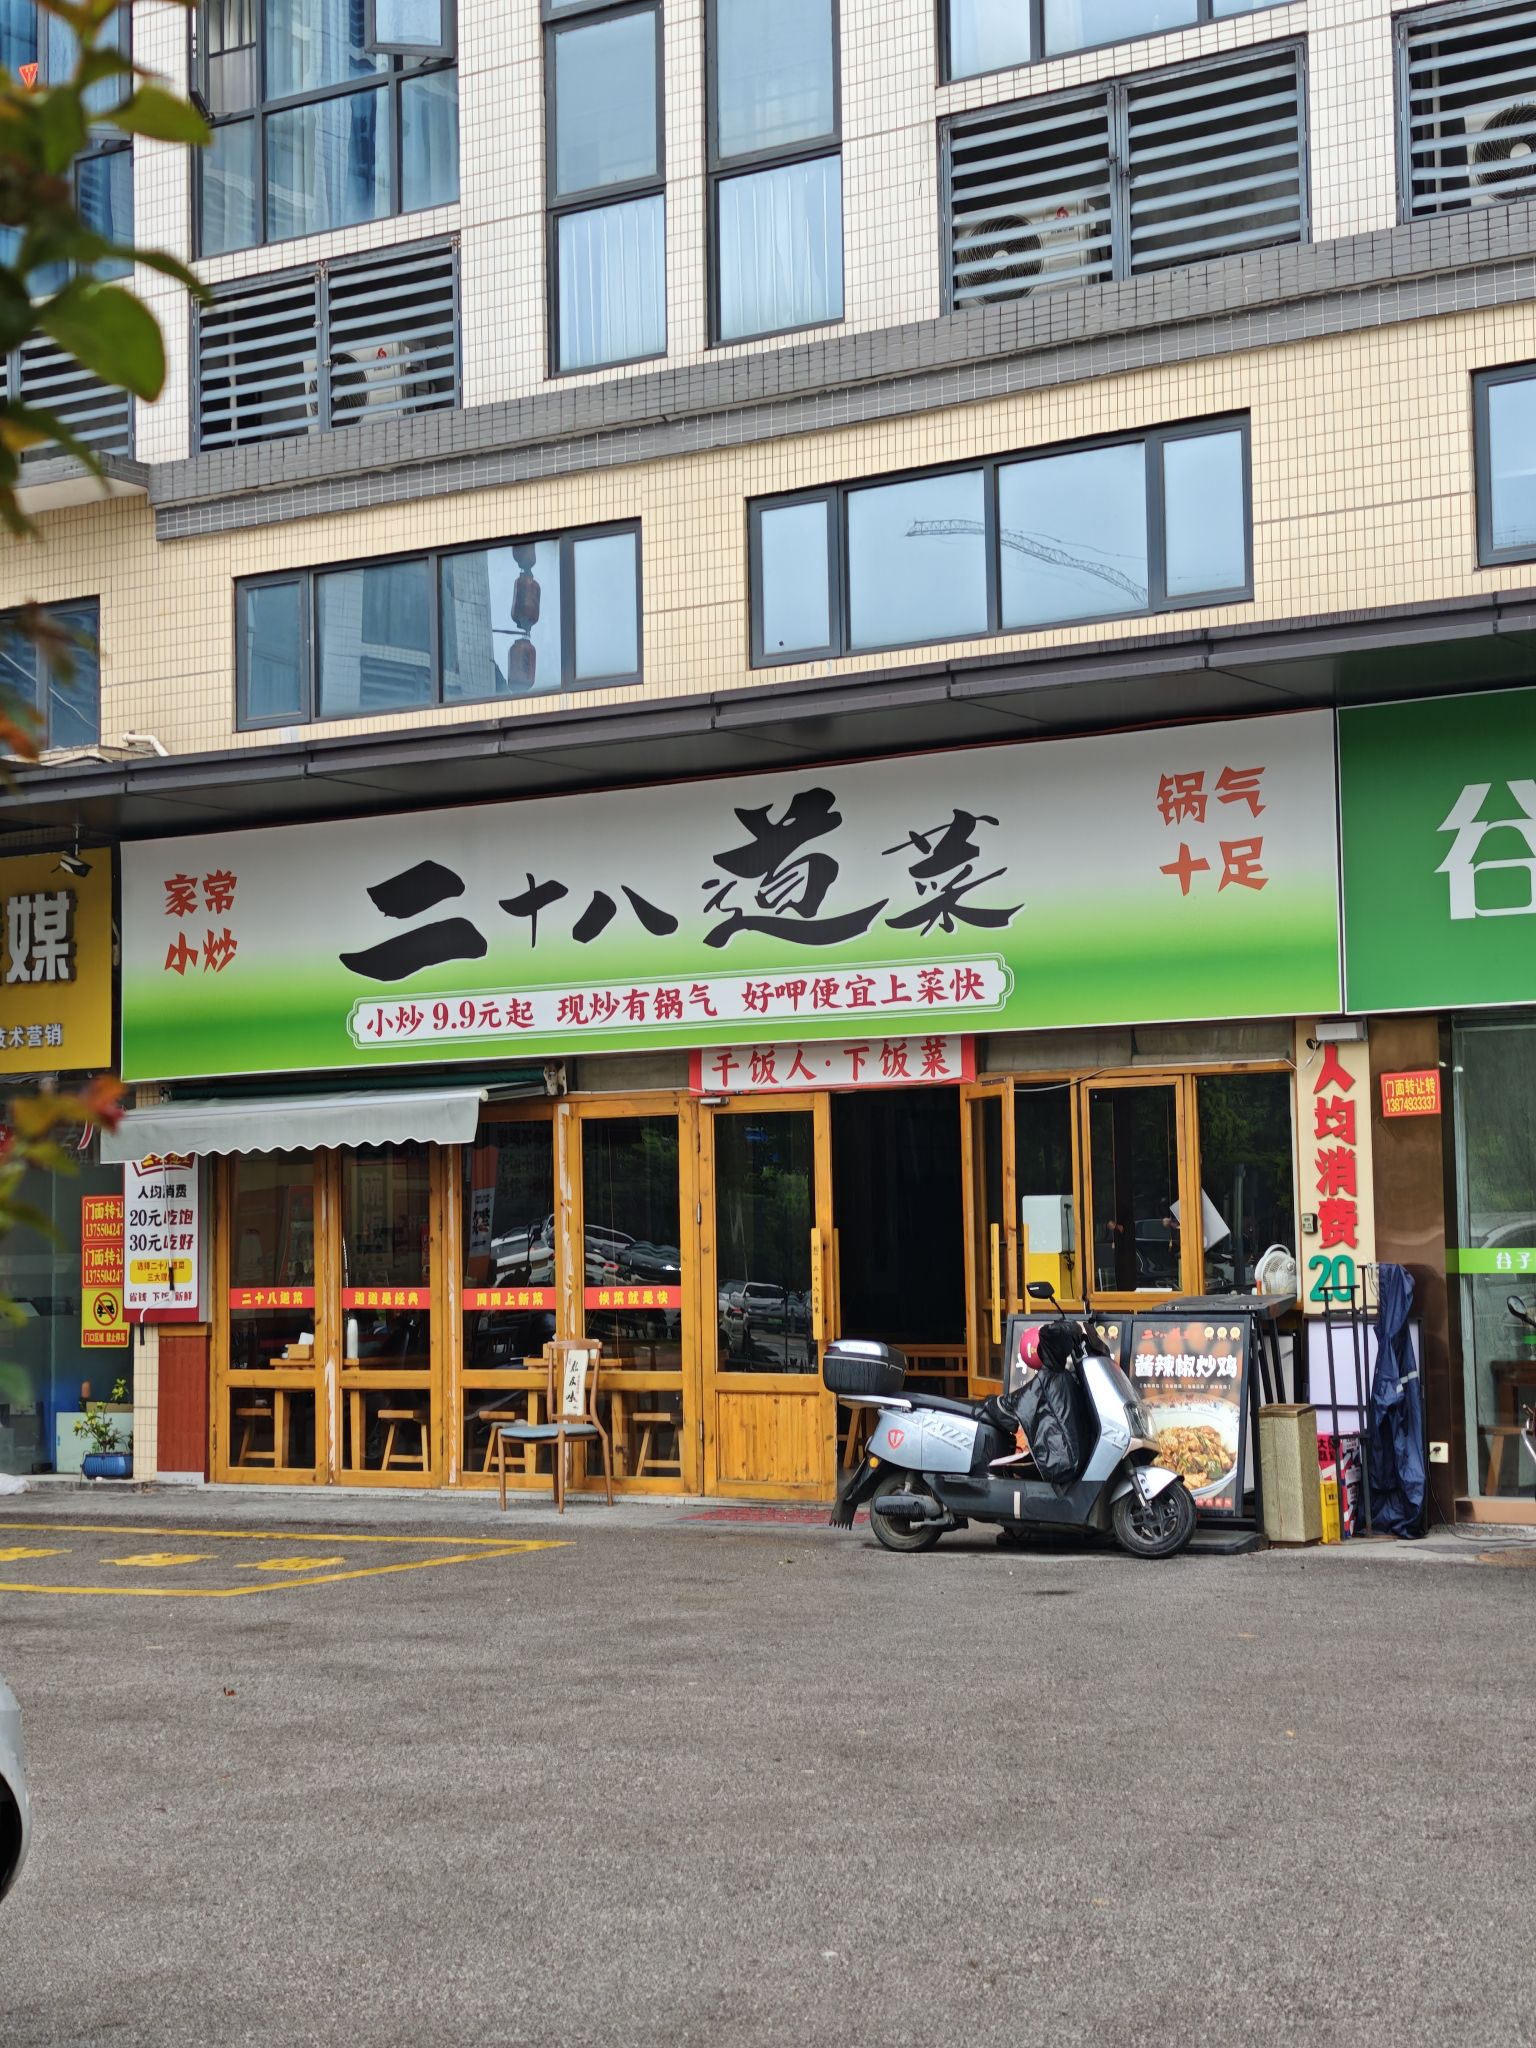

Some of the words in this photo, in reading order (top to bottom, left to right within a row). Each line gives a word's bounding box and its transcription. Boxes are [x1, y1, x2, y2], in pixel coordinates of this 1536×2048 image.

[1157, 766, 1266, 826] 锅气
[340, 787, 1025, 982] 二十八道菜
[1160, 836, 1269, 897] 十足
[164, 869, 237, 917] 家常
[6, 891, 70, 984] 媒
[164, 928, 237, 976] 小炒
[556, 984, 718, 1026] 现炒有锅气
[741, 967, 985, 1013] 好呷便宜上菜快
[1385, 1076, 1436, 1097] 门面转让转
[1386, 1095, 1436, 1112] 13874933337
[1313, 1043, 1359, 1249] 人均消费
[138, 1184, 187, 1199] 人均消费
[129, 1208, 194, 1227] 20元吃饱
[129, 1234, 194, 1252] 30元吃好
[148, 1272, 174, 1282] 三大理
[241, 1291, 303, 1305] 二十八道菜
[1309, 1255, 1356, 1302] 20
[1135, 1353, 1238, 1378] 酱辣椒炒鸡
